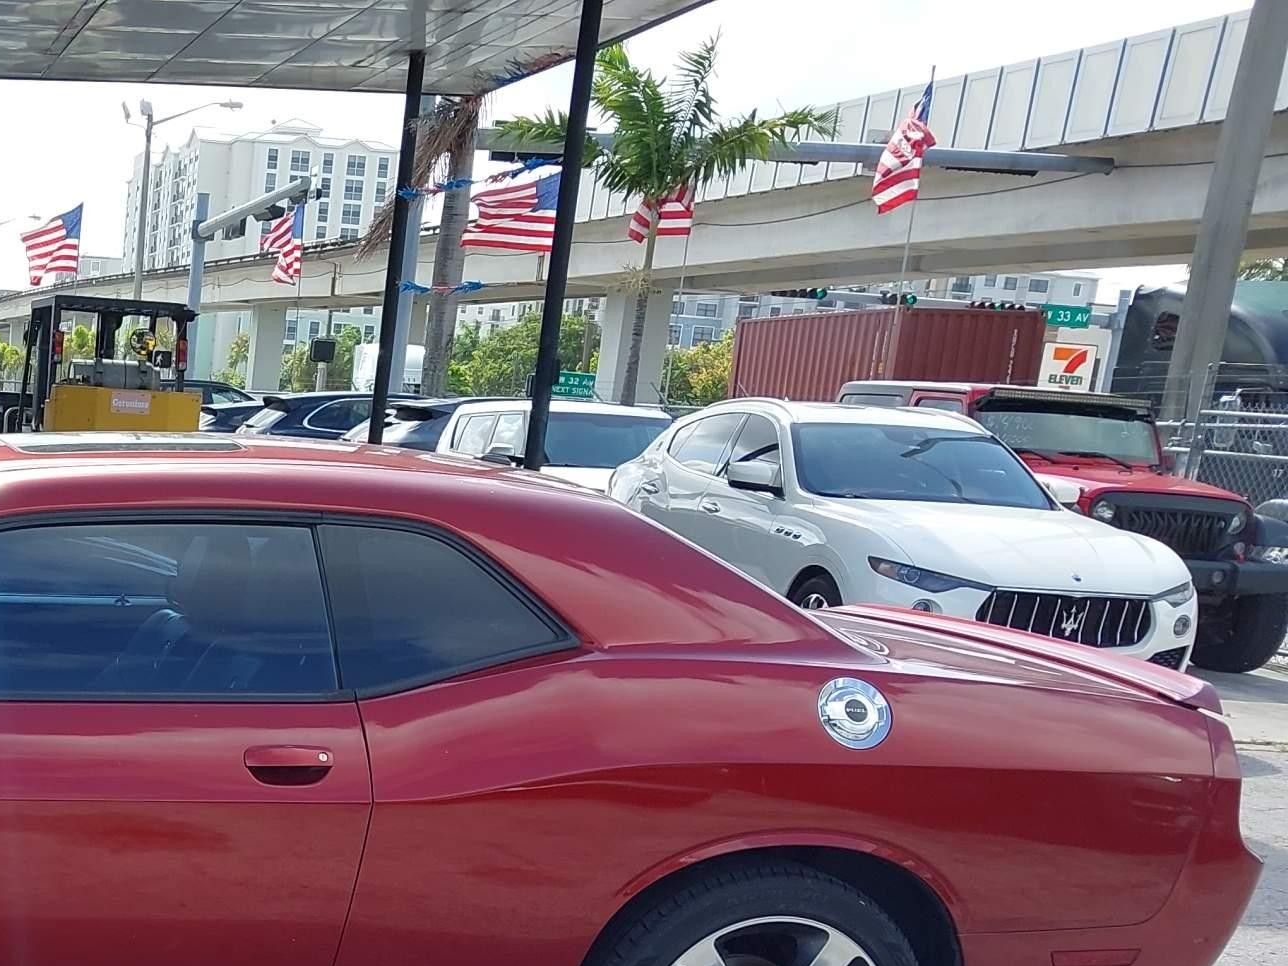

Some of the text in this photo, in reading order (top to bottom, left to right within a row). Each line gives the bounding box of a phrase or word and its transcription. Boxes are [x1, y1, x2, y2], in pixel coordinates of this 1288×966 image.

[1057, 310, 1071, 322] 33
[1074, 313, 1089, 322] AV
[1053, 347, 1089, 374] 7
[568, 377, 580, 385] 32
